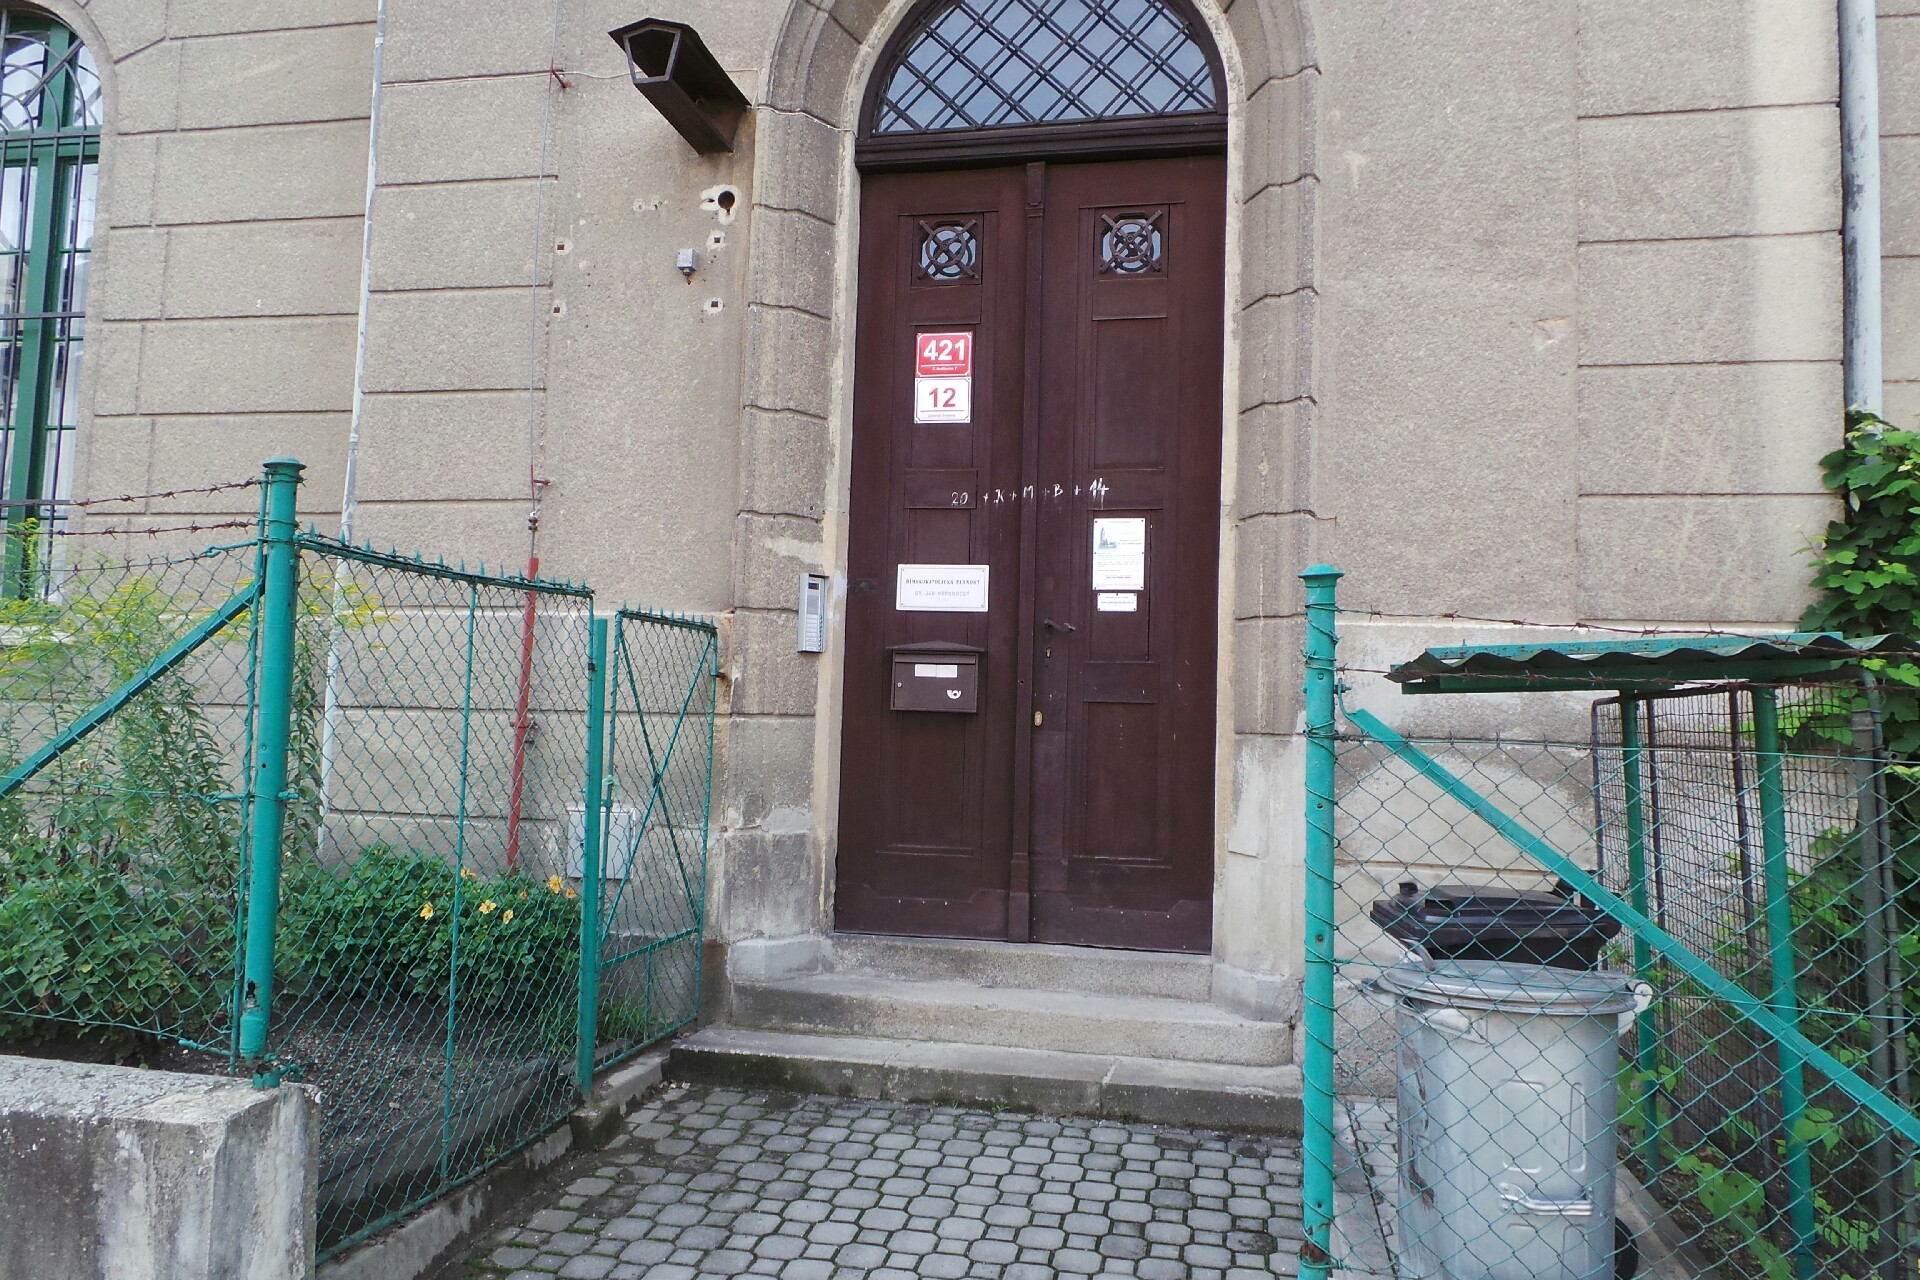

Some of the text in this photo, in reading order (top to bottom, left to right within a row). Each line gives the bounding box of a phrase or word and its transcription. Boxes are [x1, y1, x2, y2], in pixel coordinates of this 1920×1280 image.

[923, 338, 965, 361] 421
[928, 387, 956, 408] 12
[951, 491, 969, 505] 20
[1023, 485, 1034, 500] M
[1053, 483, 1064, 497] B
